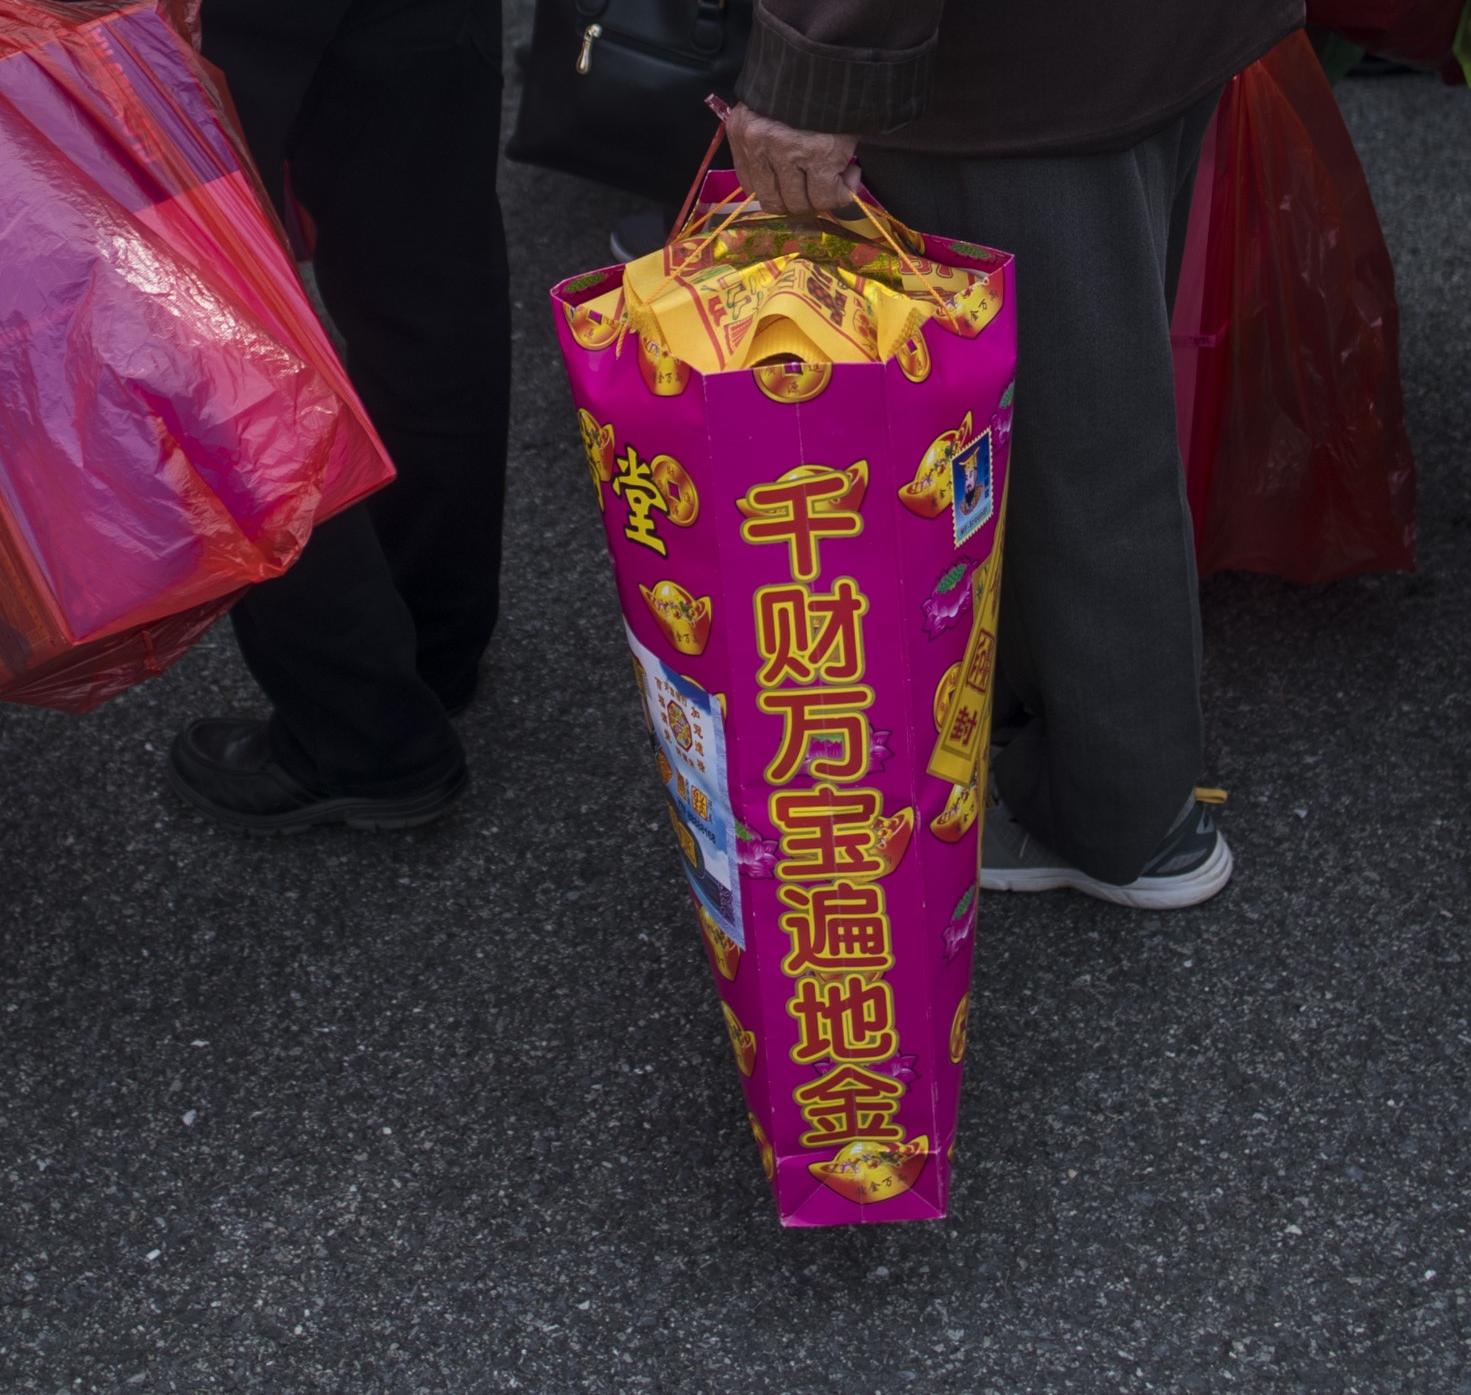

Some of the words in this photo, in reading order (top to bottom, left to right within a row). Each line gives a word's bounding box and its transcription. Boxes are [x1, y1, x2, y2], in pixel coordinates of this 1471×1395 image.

[611, 443, 671, 559] 堂
[949, 705, 977, 747] 封
[738, 470, 903, 1150] 千财万宝遍地金
